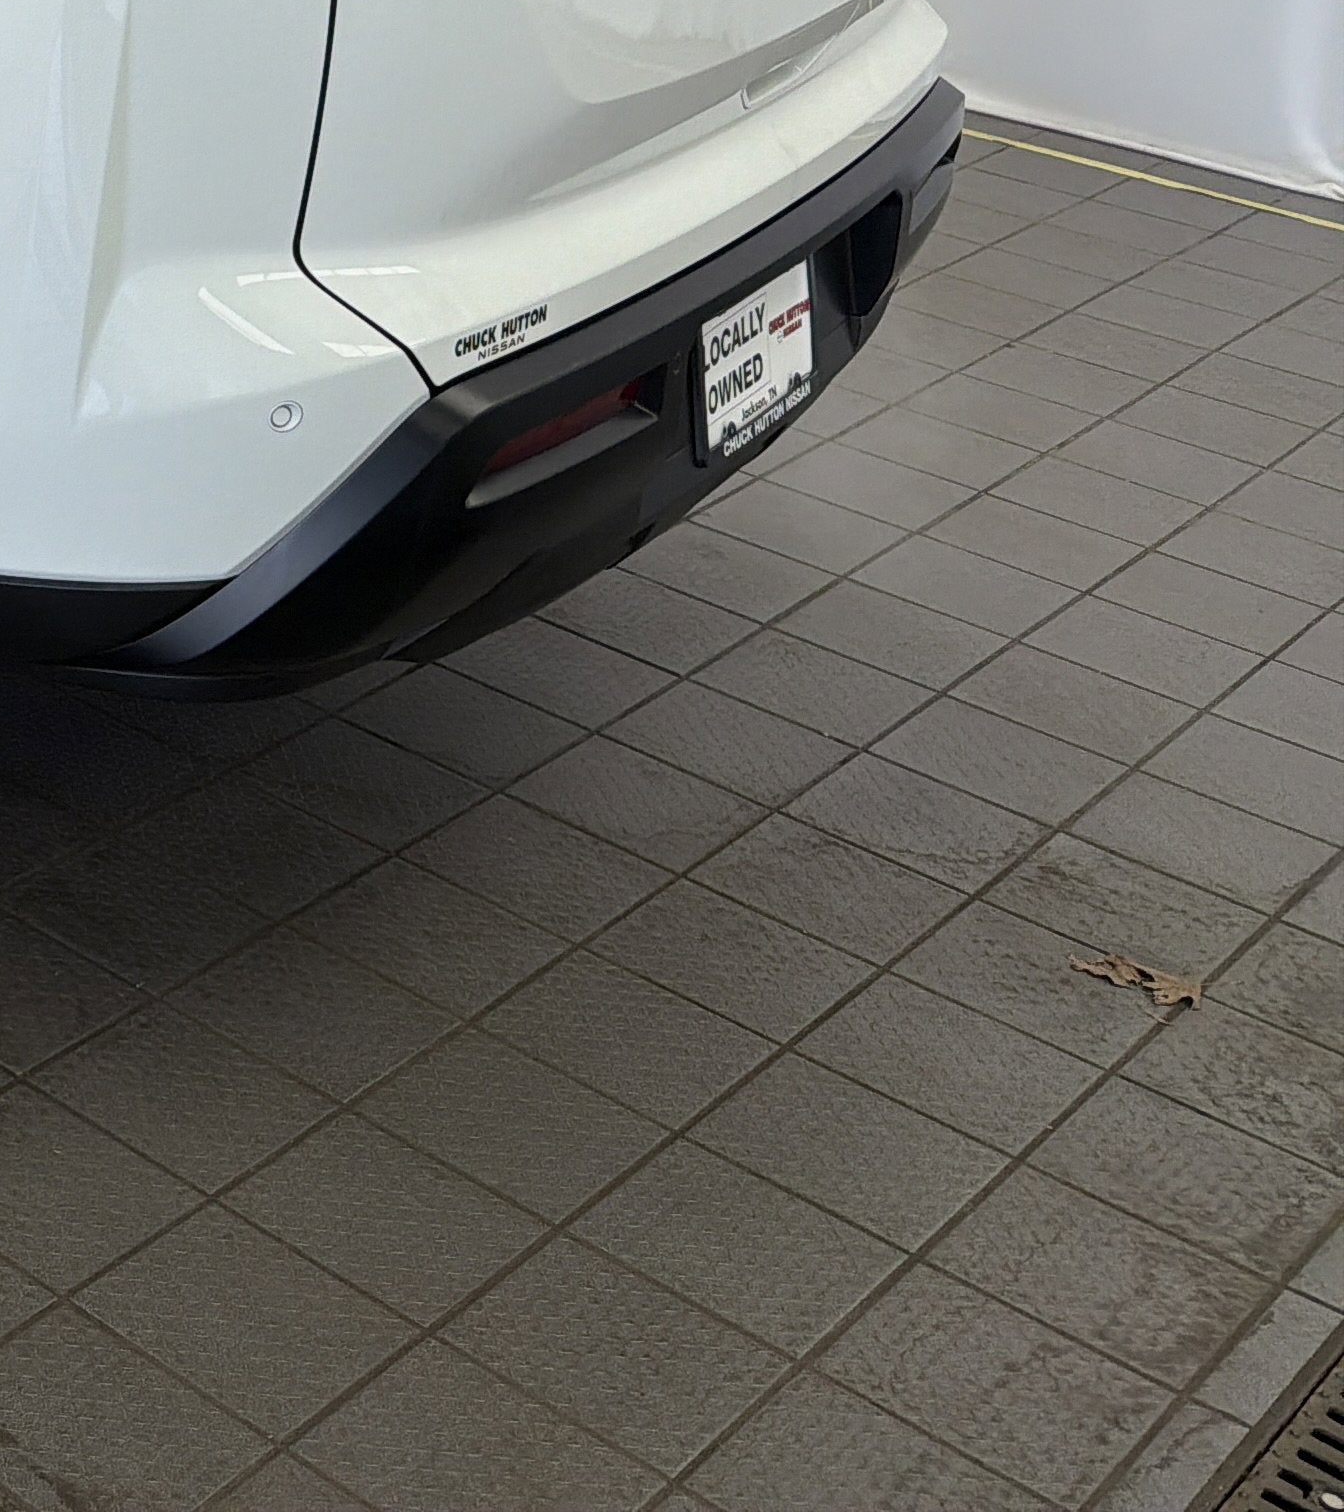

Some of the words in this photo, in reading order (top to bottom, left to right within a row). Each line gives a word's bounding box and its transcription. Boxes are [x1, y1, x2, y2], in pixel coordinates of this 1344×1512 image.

[455, 325, 497, 357] CHUCK
[501, 304, 548, 340] HUTTON
[477, 333, 526, 361] NISSAN
[703, 303, 766, 372] LOCALLY
[709, 353, 764, 415] OWNED
[723, 427, 754, 457] CHUCK
[754, 402, 785, 437] HUTTON
[786, 379, 811, 414] NISSAN
